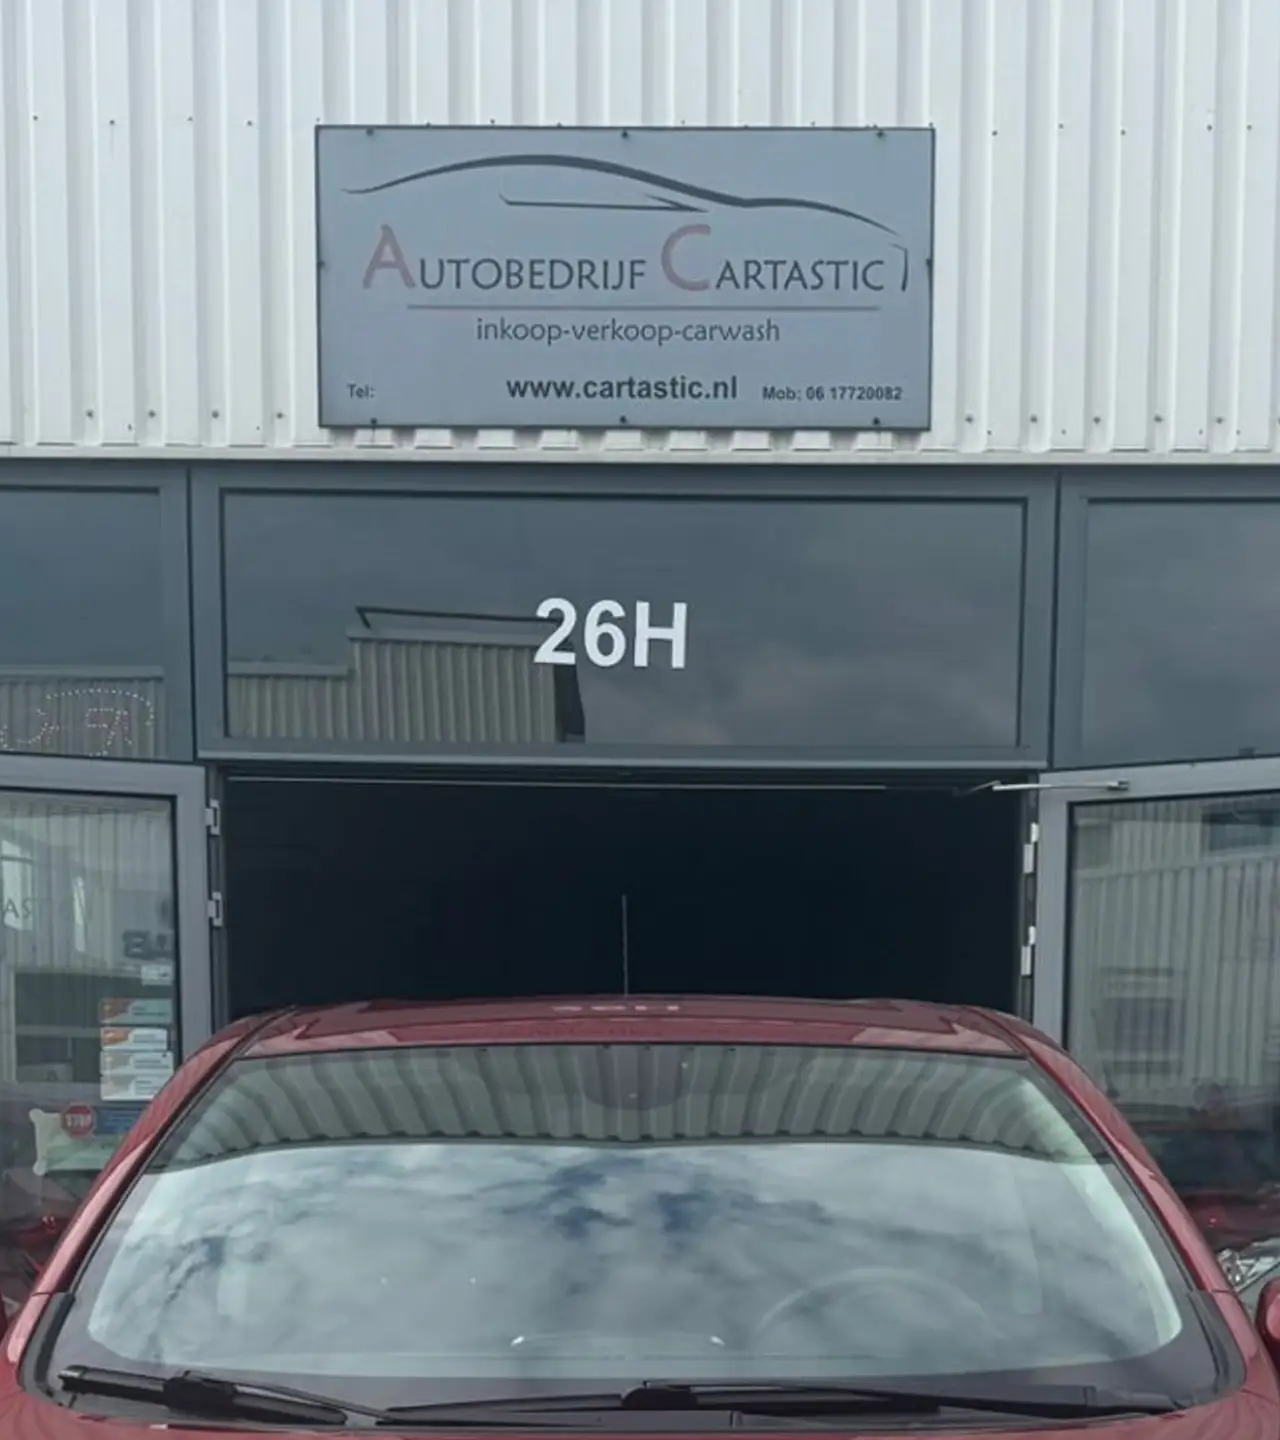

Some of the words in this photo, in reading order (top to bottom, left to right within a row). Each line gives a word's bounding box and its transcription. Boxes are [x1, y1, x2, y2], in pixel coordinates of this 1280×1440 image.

[362, 224, 646, 291] AUTOBEDRIJF
[660, 224, 885, 292] CARTASTIC
[475, 316, 781, 346] inkoop-verkoop-carwash
[347, 383, 375, 399] Tel:
[506, 375, 738, 400] www.cartastic.nl
[806, 386, 825, 400] 06
[830, 386, 903, 400] 17720082
[533, 597, 688, 670] 26H
